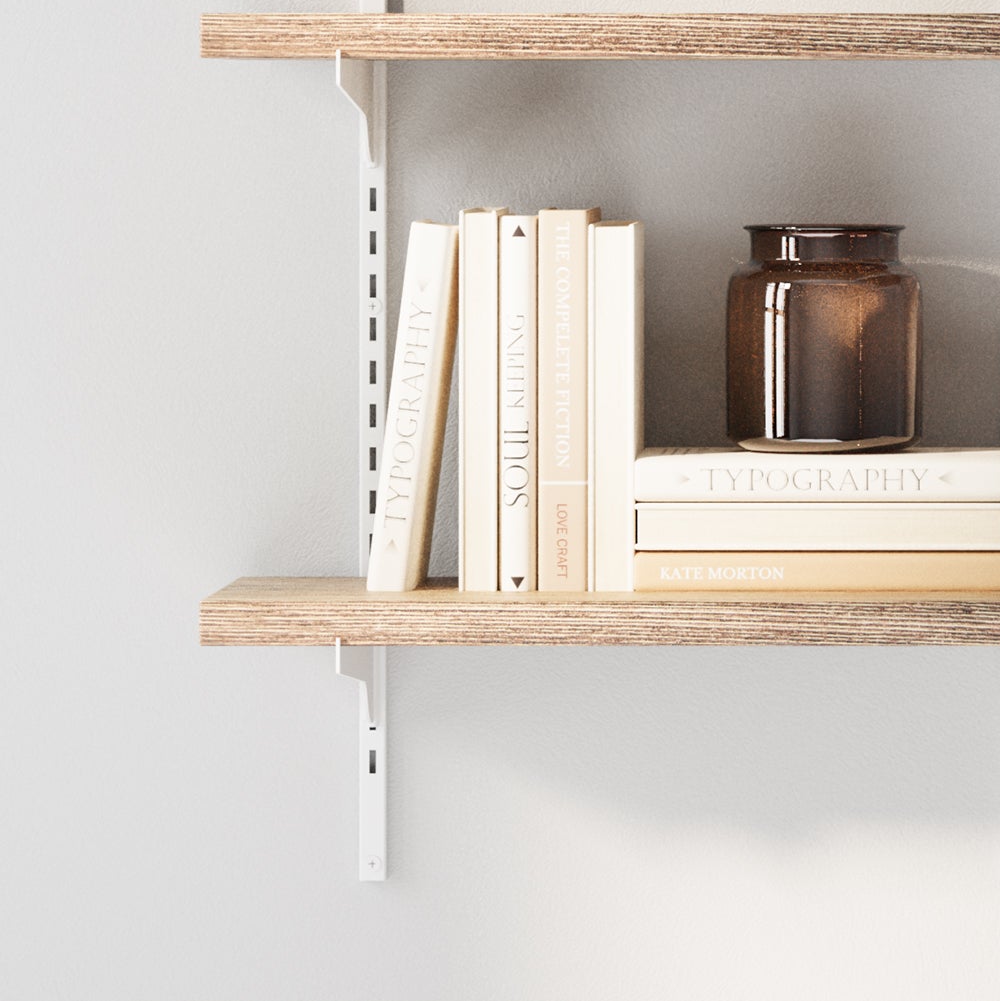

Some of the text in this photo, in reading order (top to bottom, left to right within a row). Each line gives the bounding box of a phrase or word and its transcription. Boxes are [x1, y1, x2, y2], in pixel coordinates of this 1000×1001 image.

[555, 221, 571, 469] THE COMPELETE FICTION
[384, 302, 432, 528] TYPOGRAPHY
[504, 421, 530, 508] SOUL
[699, 468, 929, 491] TYPOGRAPHY
[556, 503, 569, 580] LOVE CRAFT
[660, 566, 785, 581] KATE MORTON
